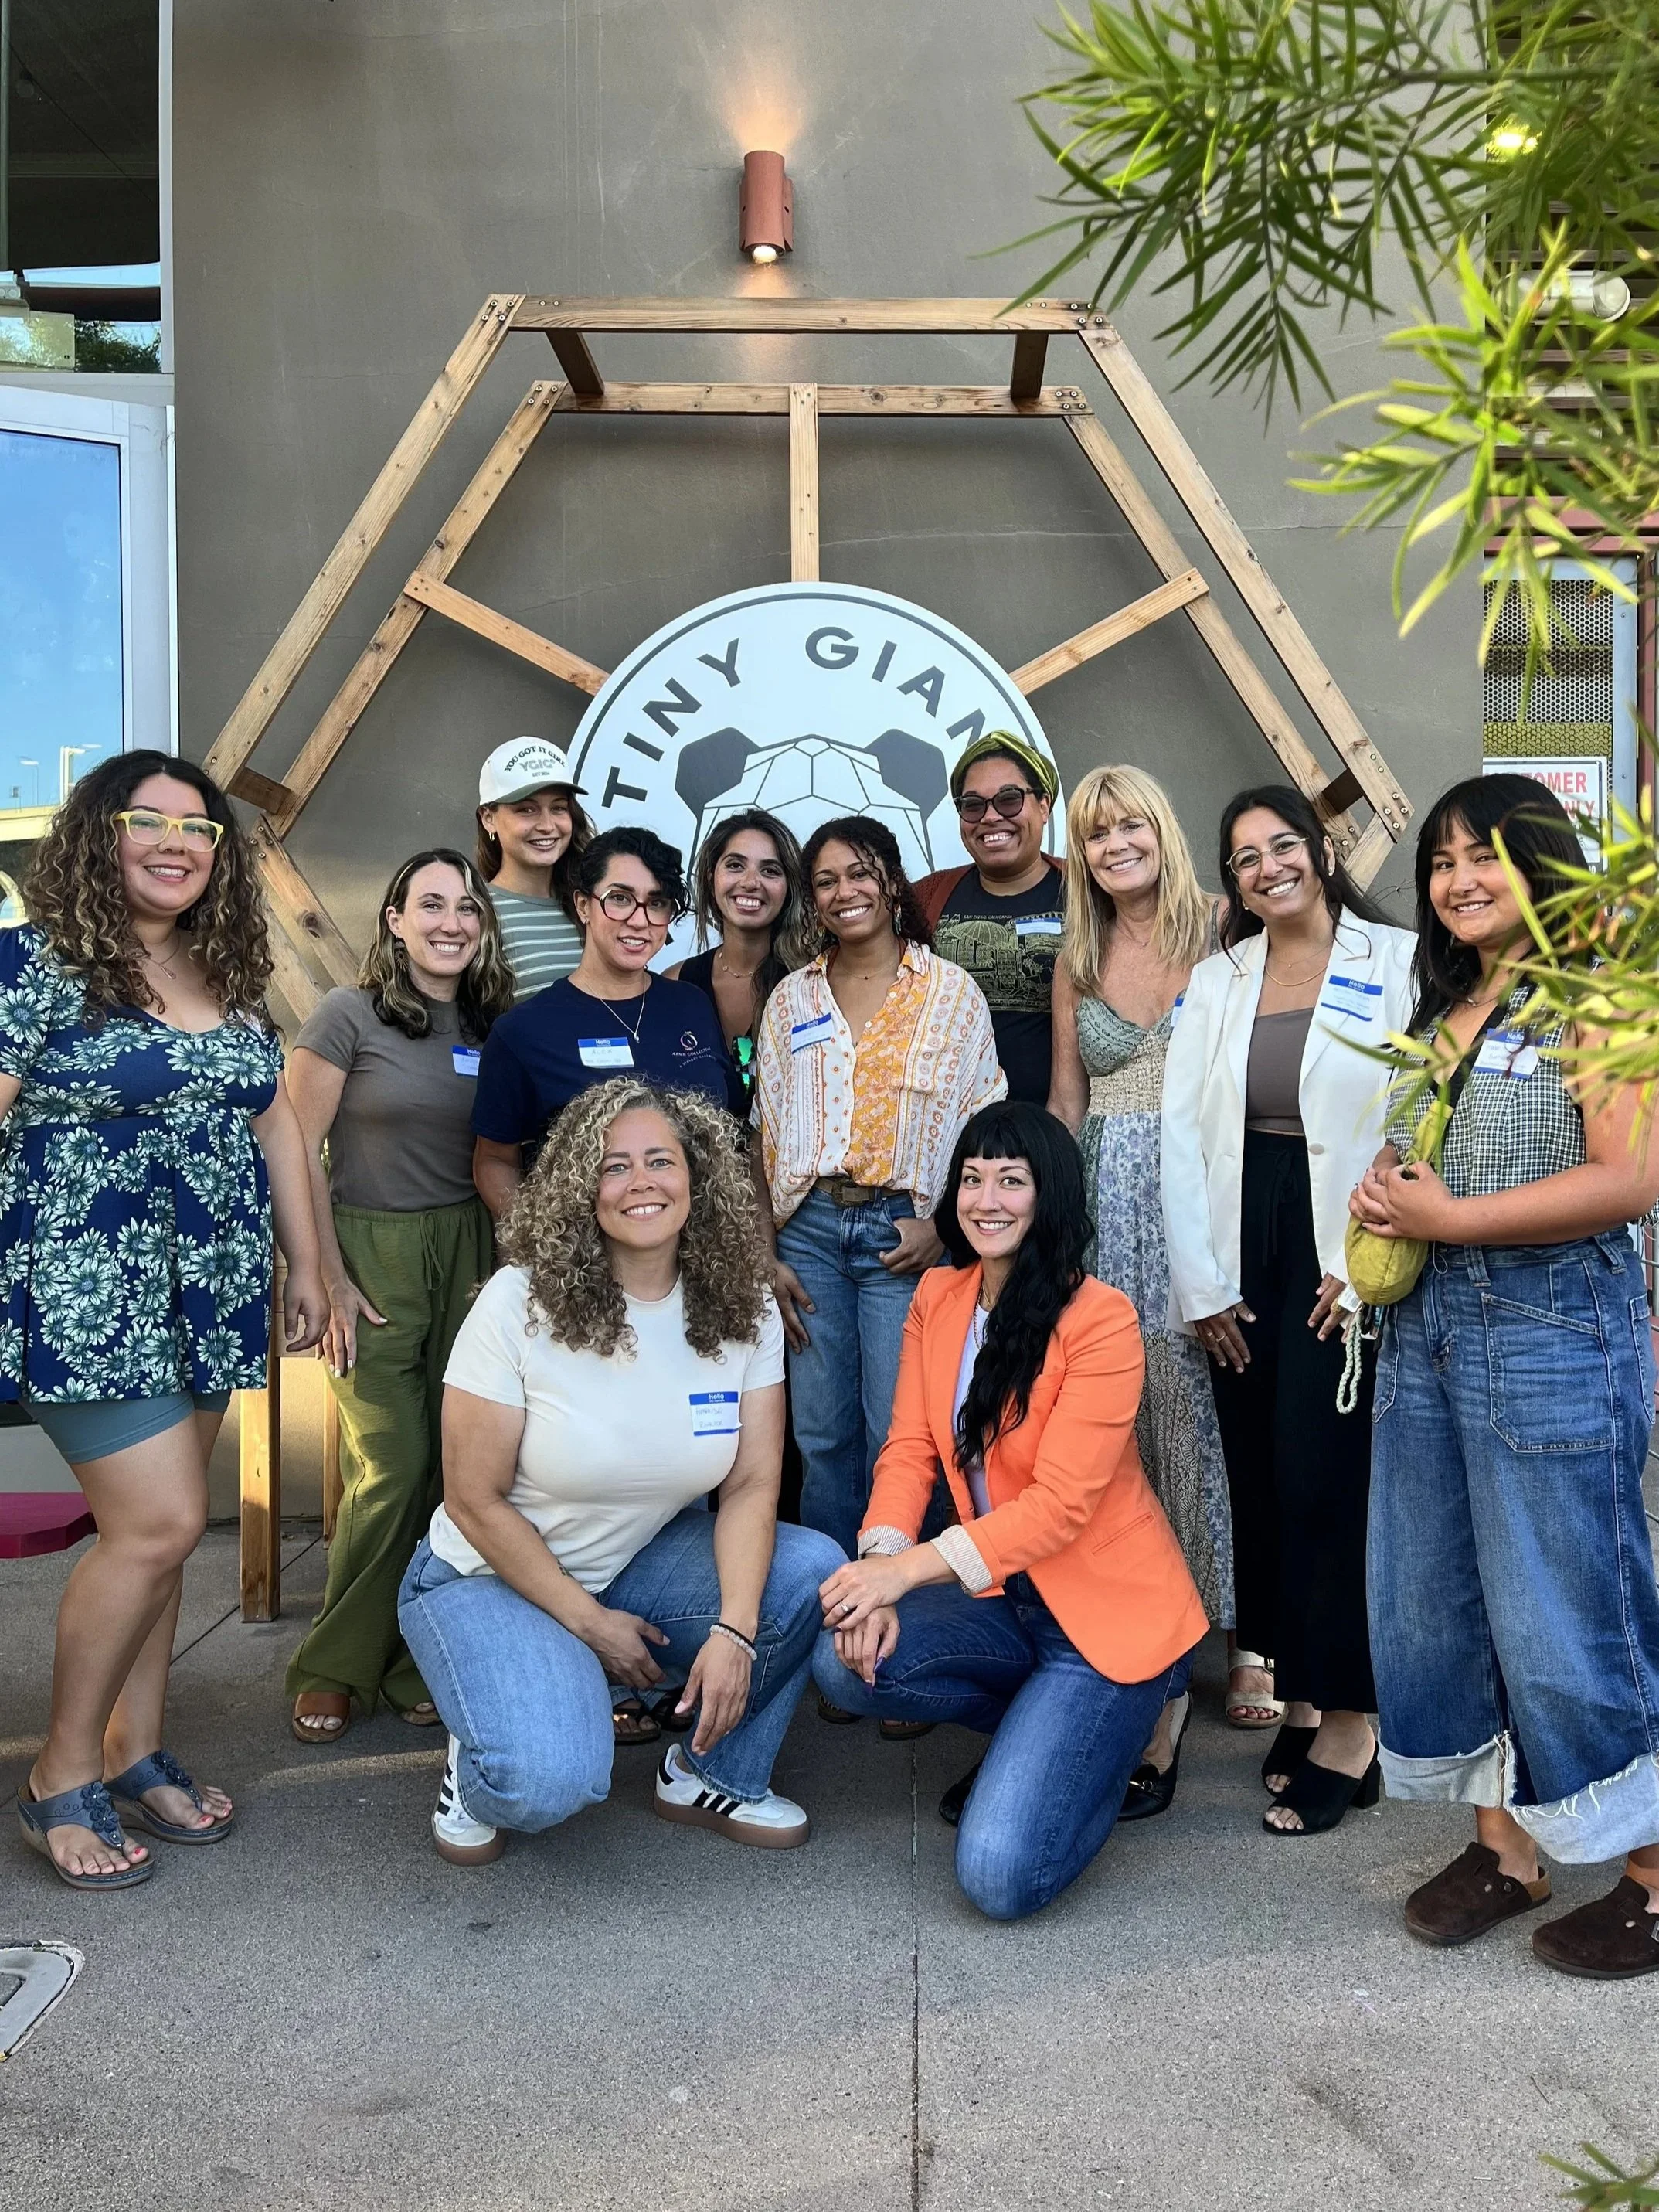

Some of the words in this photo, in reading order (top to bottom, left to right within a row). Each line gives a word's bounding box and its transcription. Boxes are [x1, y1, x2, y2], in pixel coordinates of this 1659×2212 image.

[601, 638, 741, 808] TINY
[805, 626, 986, 752] GIAN
[504, 755, 518, 771] YOU
[518, 746, 536, 757] GOT
[538, 746, 546, 754] IT
[548, 750, 566, 767] GIRL
[1348, 979, 1365, 989] Hello
[1506, 1033, 1525, 1041] Hello
